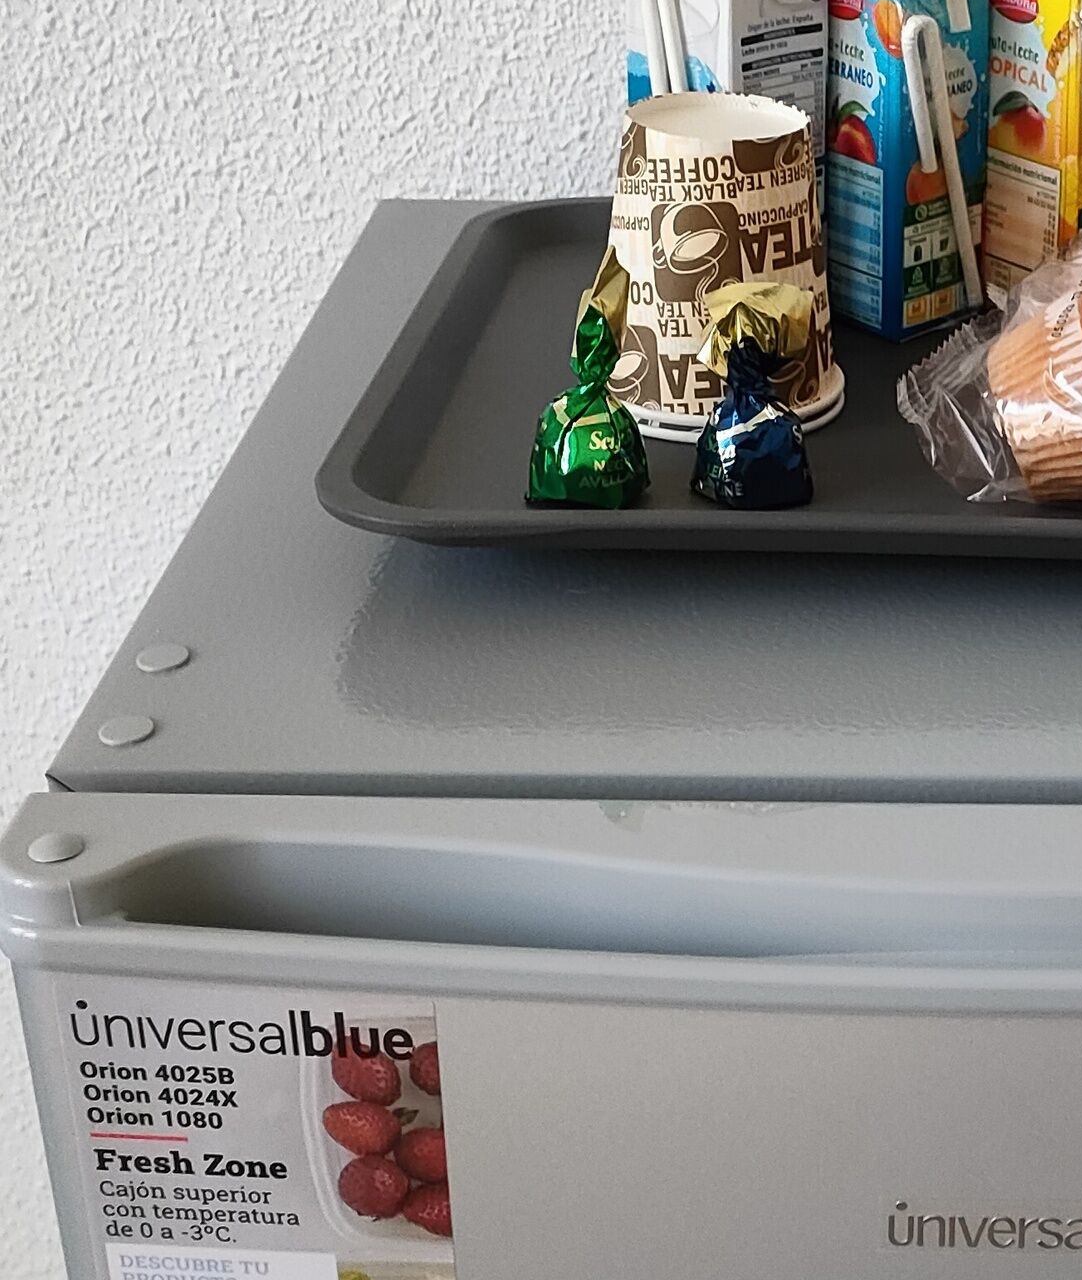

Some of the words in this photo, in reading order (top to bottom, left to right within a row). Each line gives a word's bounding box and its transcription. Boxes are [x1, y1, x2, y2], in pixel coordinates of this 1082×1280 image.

[990, 55, 1048, 94] OPICAL
[649, 154, 736, 184] COFFEE
[770, 163, 807, 188] GREEN
[650, 185, 676, 202] TEA
[683, 181, 738, 202] BLACK
[735, 173, 766, 193] TEA
[739, 198, 809, 227] CAPPUCCINO
[740, 215, 813, 275] TEA
[656, 302, 685, 318] TEA
[658, 319, 693, 338] TEA
[80, 1061, 148, 1081] Orion
[155, 1064, 235, 1085] 4025B
[83, 1084, 151, 1104] Orion
[157, 1087, 239, 1108] 4024X
[87, 1107, 154, 1126] Orion
[161, 1110, 223, 1130] 1080
[93, 1148, 196, 1175] Fresh
[203, 1153, 288, 1179] Zone
[100, 1180, 167, 1202] Cajón
[173, 1185, 272, 1206] superior
[102, 1203, 147, 1219] con
[152, 1203, 301, 1226] temperatura
[106, 1220, 134, 1238] de
[140, 1222, 153, 1239] 0
[160, 1226, 174, 1240] a
[119, 1254, 234, 1273] DESCUBRE
[239, 1261, 270, 1276] TU
